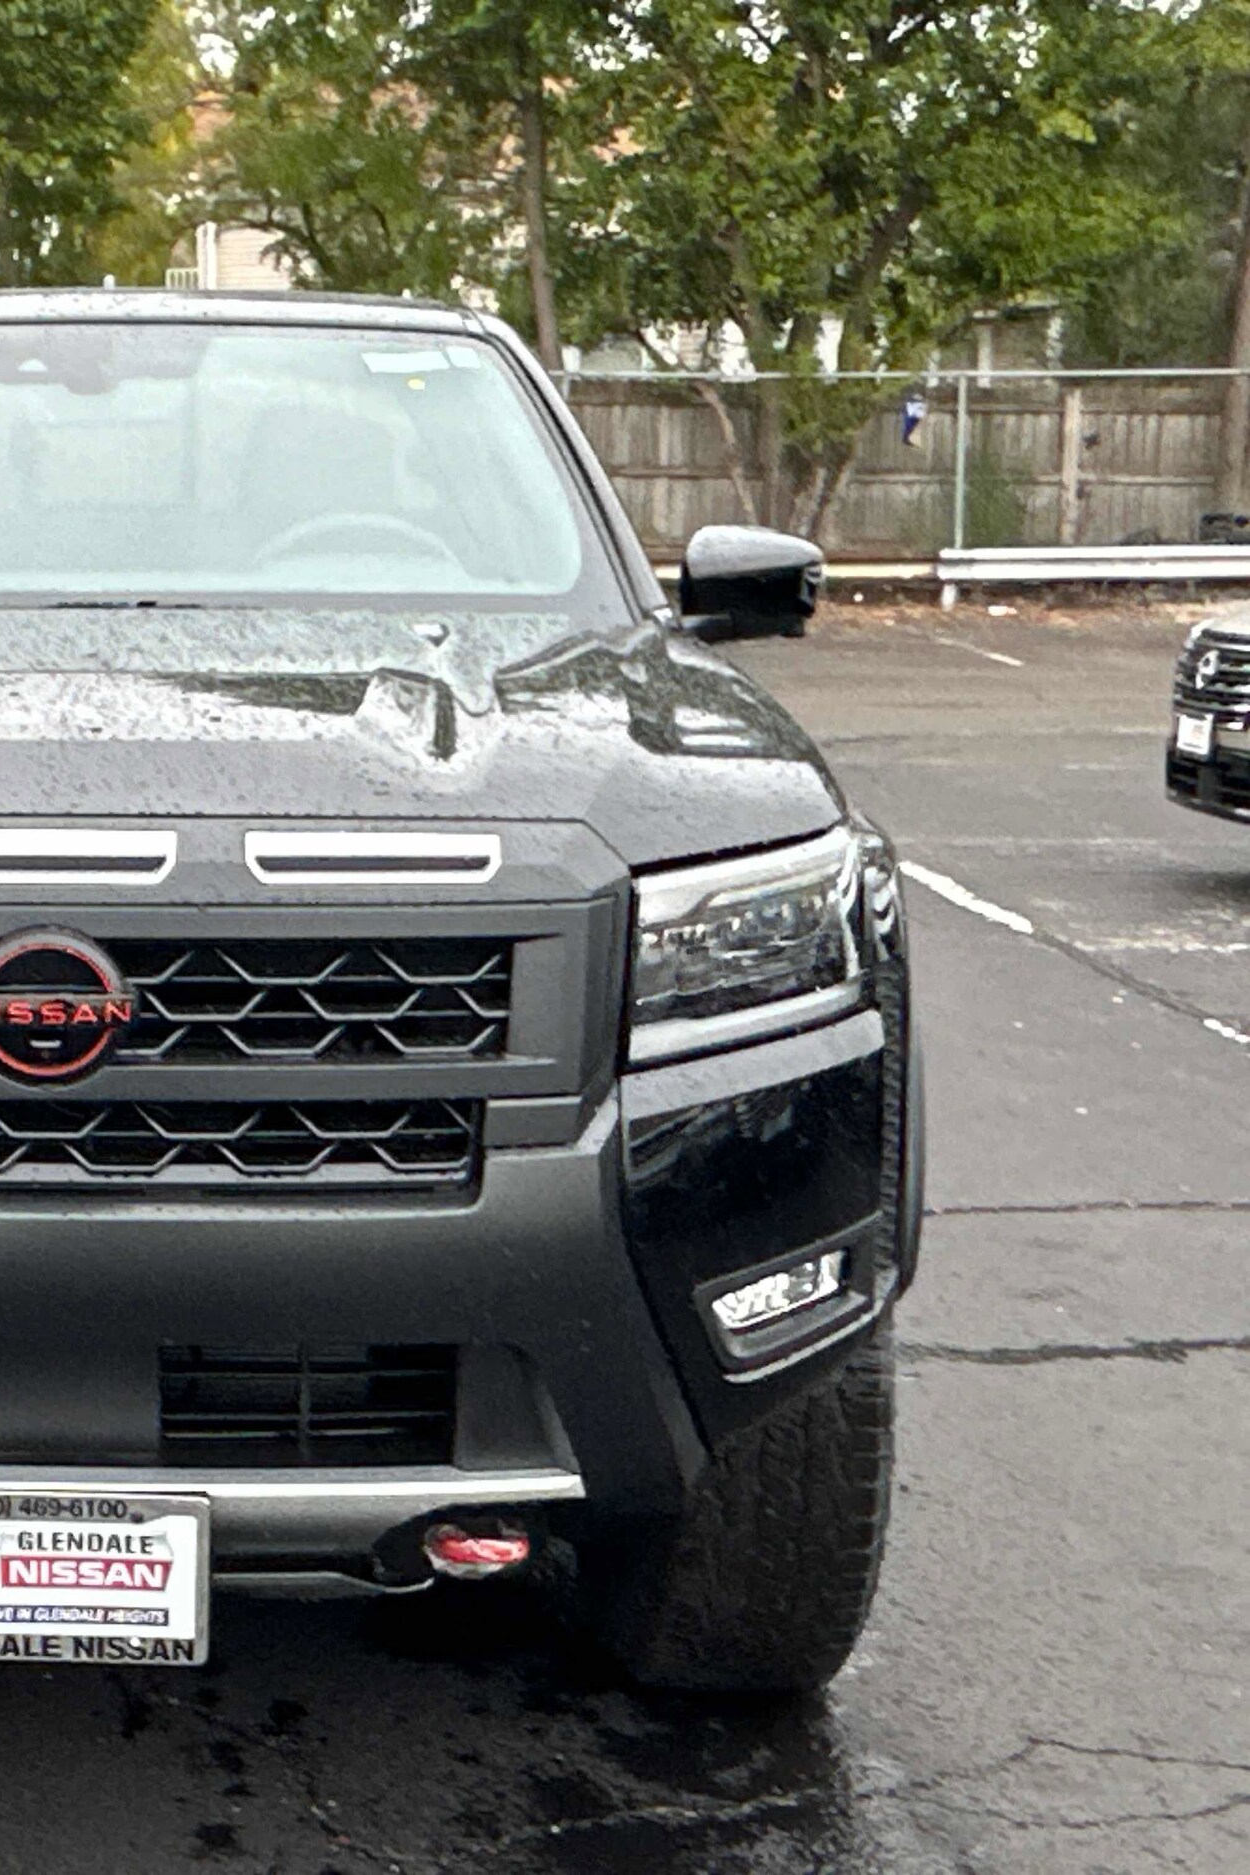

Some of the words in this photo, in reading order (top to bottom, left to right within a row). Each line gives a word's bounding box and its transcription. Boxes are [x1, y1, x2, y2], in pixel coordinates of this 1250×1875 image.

[18, 1497, 128, 1520] 469-6100
[17, 1530, 154, 1555] GLENDALE
[8, 1560, 165, 1588] NISSAN
[72, 1637, 196, 1662] NISSAN
